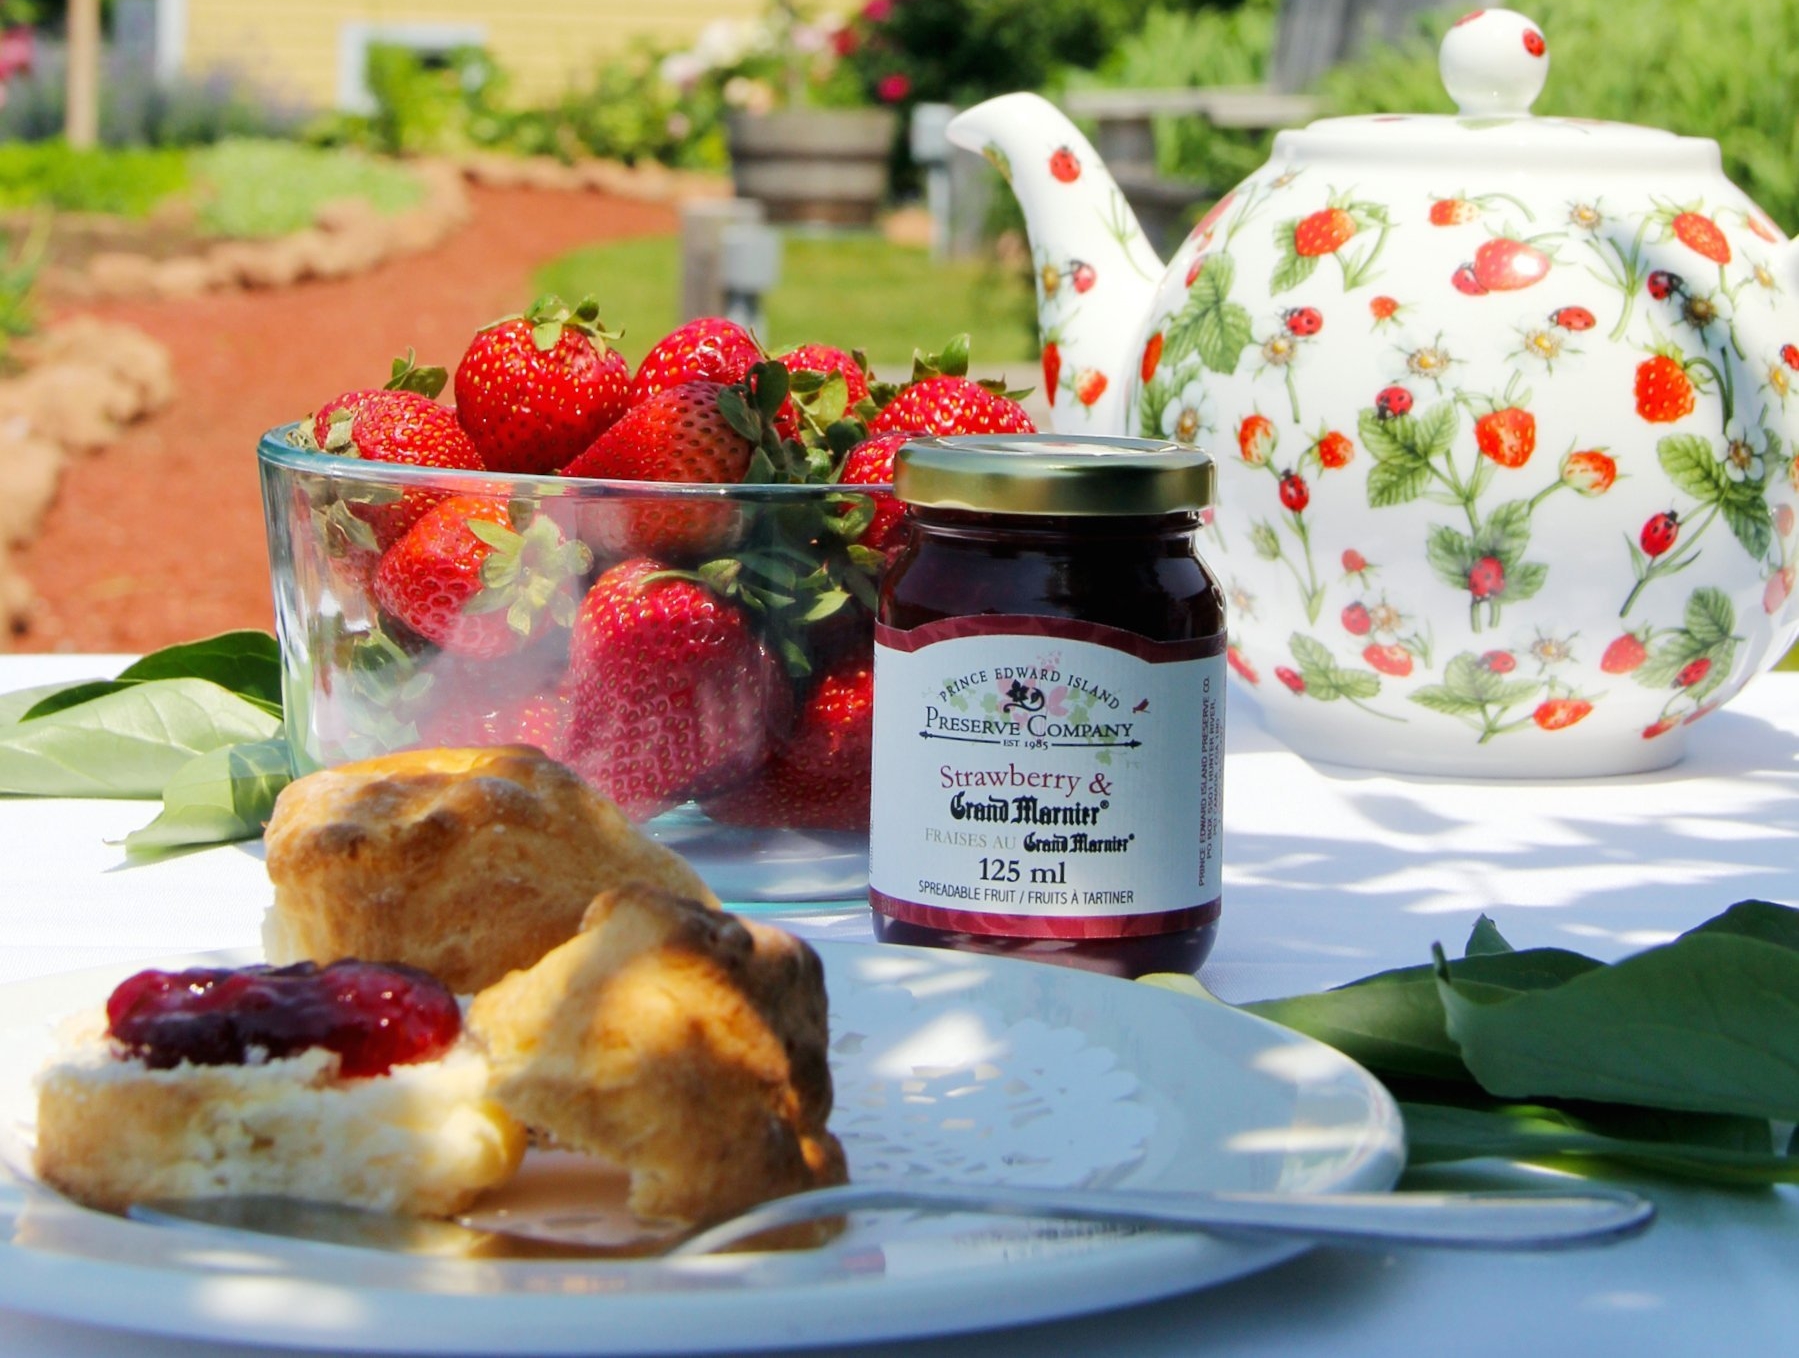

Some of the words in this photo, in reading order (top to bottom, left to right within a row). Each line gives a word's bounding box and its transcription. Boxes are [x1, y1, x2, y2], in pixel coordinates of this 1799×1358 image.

[940, 670, 988, 702] PRINCE
[995, 667, 1061, 683] EDWARD
[1068, 675, 1120, 711] ISLAND
[926, 706, 1020, 736] PRESERVE
[1027, 715, 1133, 738] COMPANY
[1201, 697, 1209, 752] PRESERVE
[1024, 739, 1049, 751] 1985
[940, 763, 1082, 798] Strawberry
[1088, 772, 1113, 796] &
[1200, 757, 1208, 795] ISLAND
[950, 791, 1009, 824] Grand
[1199, 798, 1207, 843] EDWARD
[925, 827, 987, 849] FRAISES
[992, 835, 1016, 851] AU
[1023, 831, 1068, 853] Grand
[978, 857, 1021, 883] 125
[1029, 861, 1067, 884] ml
[918, 879, 981, 901] SPREADABLE
[984, 888, 1016, 904] FRUIT
[1019, 891, 1025, 904] /
[1028, 890, 1068, 905] FRUITS
[1070, 888, 1080, 905] À
[1082, 889, 1134, 904] TARTINER
